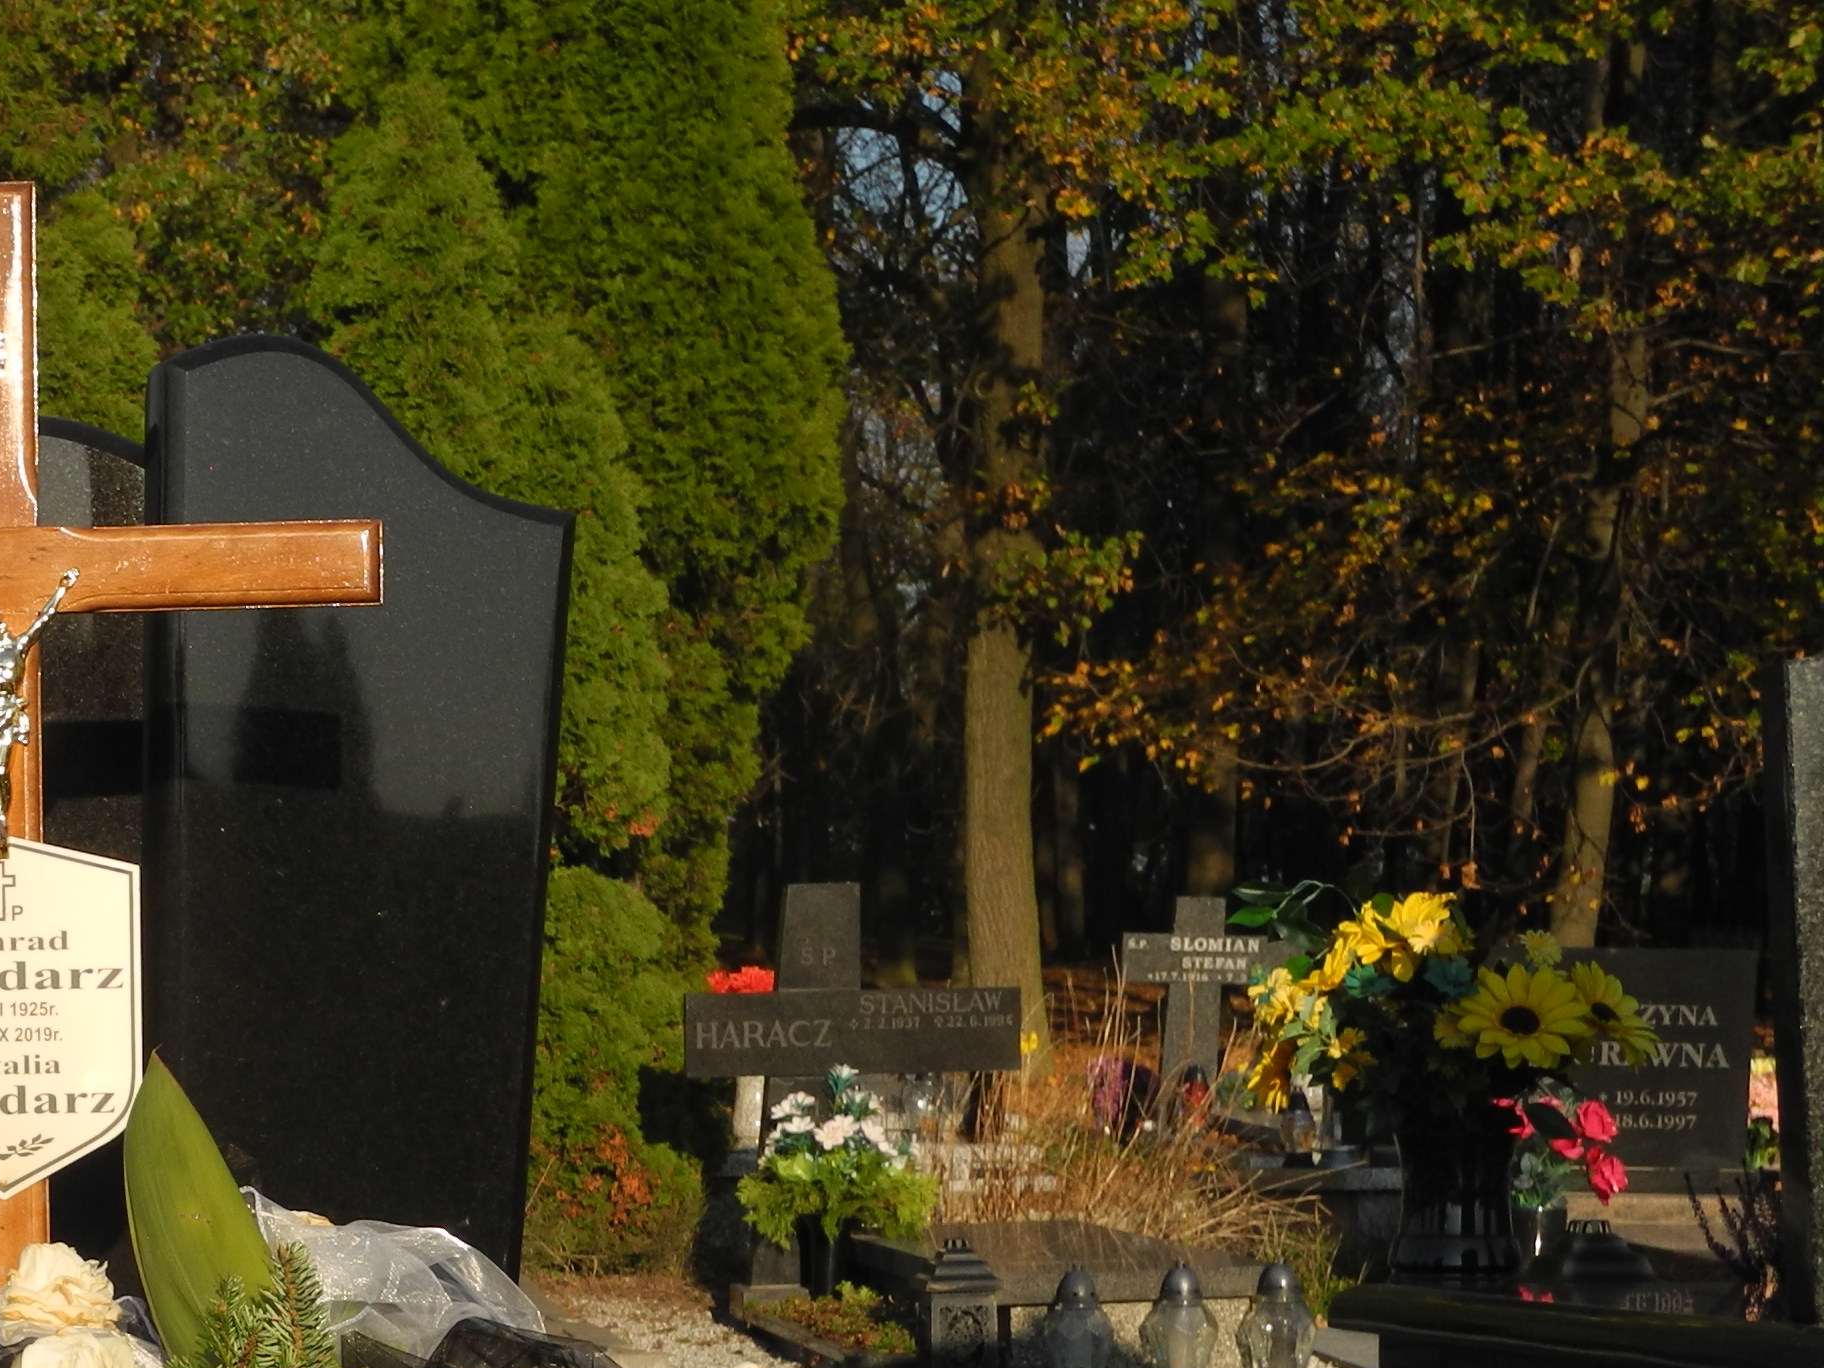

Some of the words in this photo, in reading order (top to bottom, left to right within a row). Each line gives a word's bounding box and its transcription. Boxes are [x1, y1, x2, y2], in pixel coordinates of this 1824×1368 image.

[12, 905, 24, 921] P
[1182, 956, 1247, 970] STEFAN
[9, 1001, 59, 1017] 1925r.
[14, 1026, 63, 1043] 2019r.
[695, 1018, 833, 1050] HARACZ
